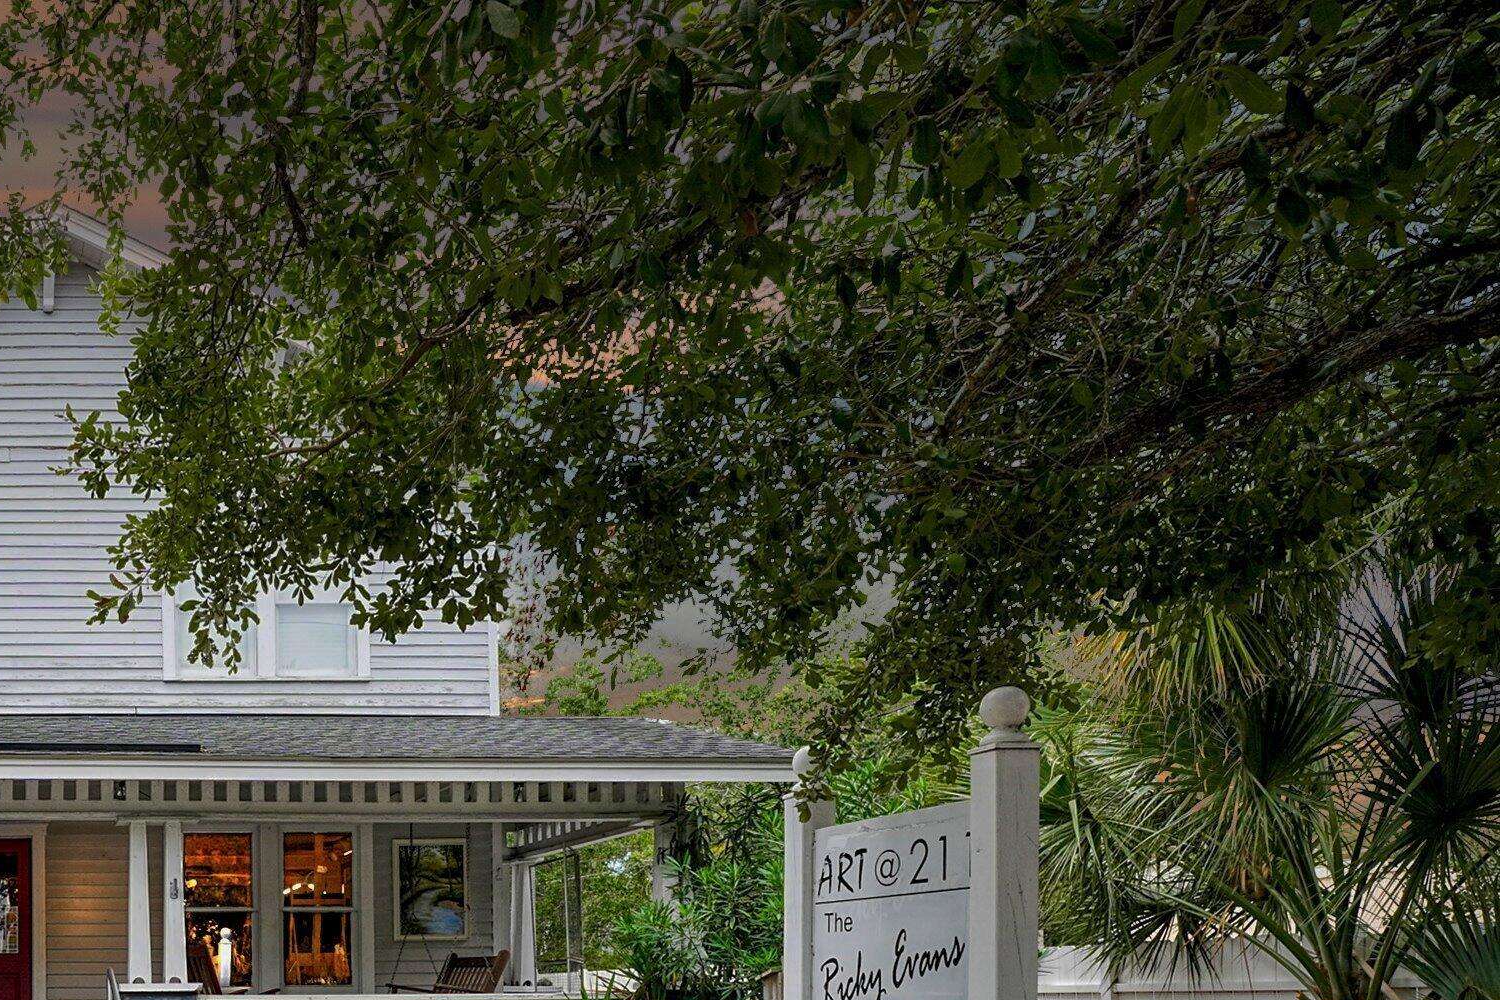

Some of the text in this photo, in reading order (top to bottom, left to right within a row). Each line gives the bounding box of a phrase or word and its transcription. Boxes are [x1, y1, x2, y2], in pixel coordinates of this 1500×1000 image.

[817, 848, 868, 896] ART
[874, 849, 901, 887] @
[824, 912, 853, 933] The
[892, 928, 966, 988] Evans
